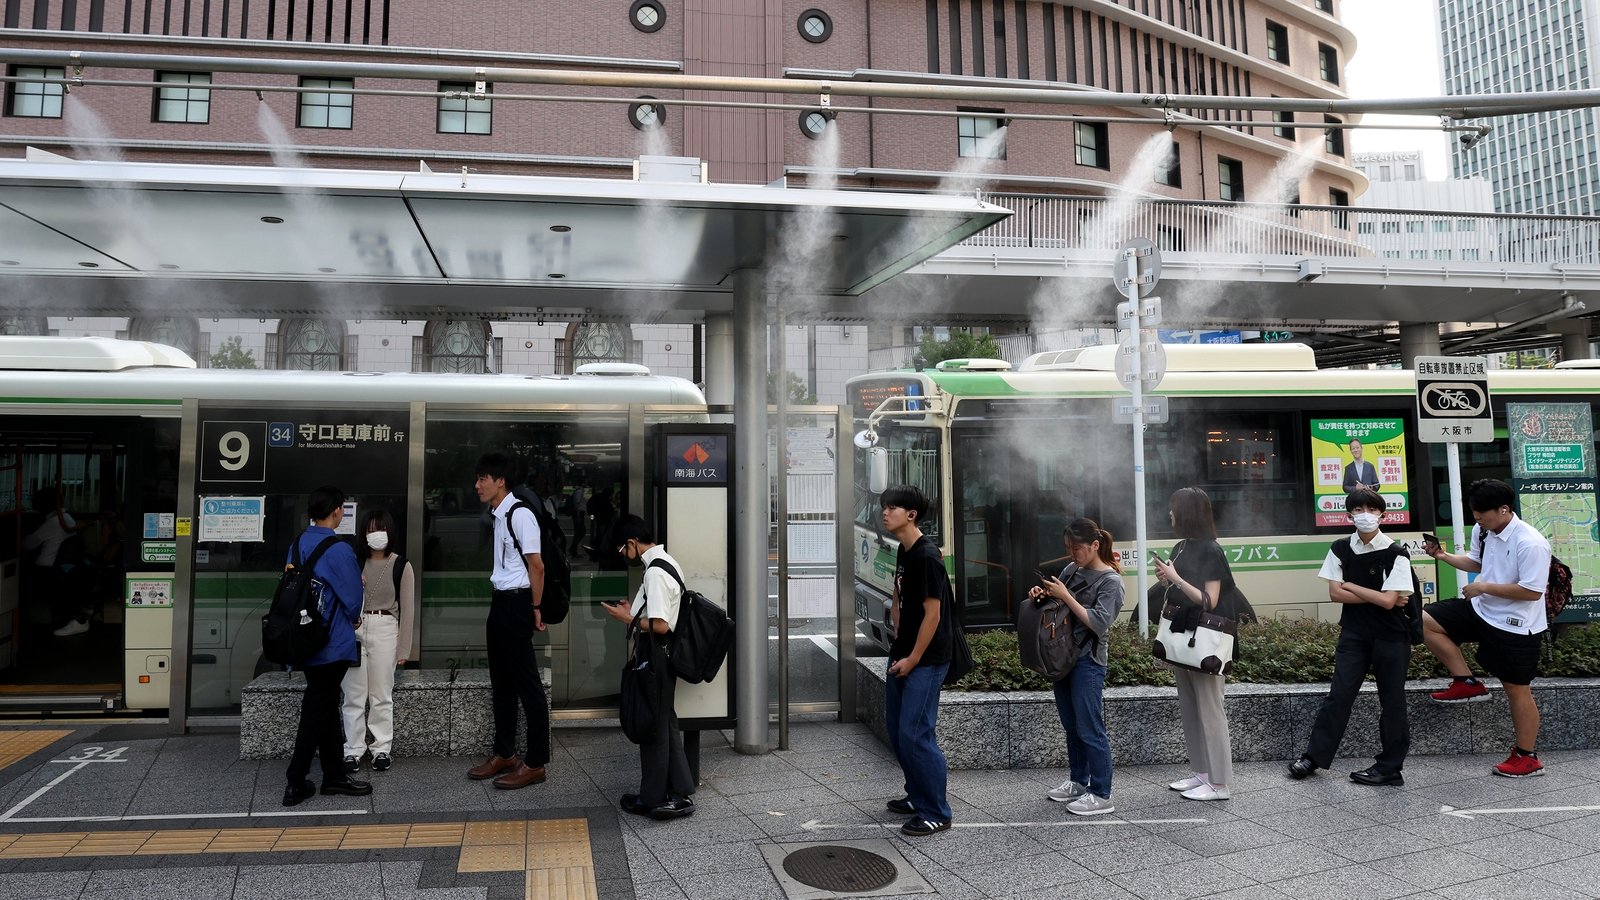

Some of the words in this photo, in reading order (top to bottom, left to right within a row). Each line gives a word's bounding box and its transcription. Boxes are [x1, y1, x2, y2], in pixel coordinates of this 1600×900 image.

[1418, 362, 1485, 375] 自転車放置禁止区域
[1318, 422, 1396, 430] 私が責任を持って対応させて
[1441, 426, 1472, 436] 大阪市
[271, 427, 291, 442] 34
[218, 430, 250, 471] 9
[674, 468, 717, 478] 南海バス
[1320, 464, 1341, 472] 査定料
[1381, 467, 1401, 475] 手数料
[1519, 482, 1594, 491] ノーポイモデルゾーン案内
[1121, 550, 1138, 560] 出口
[68, 746, 130, 761] 34
